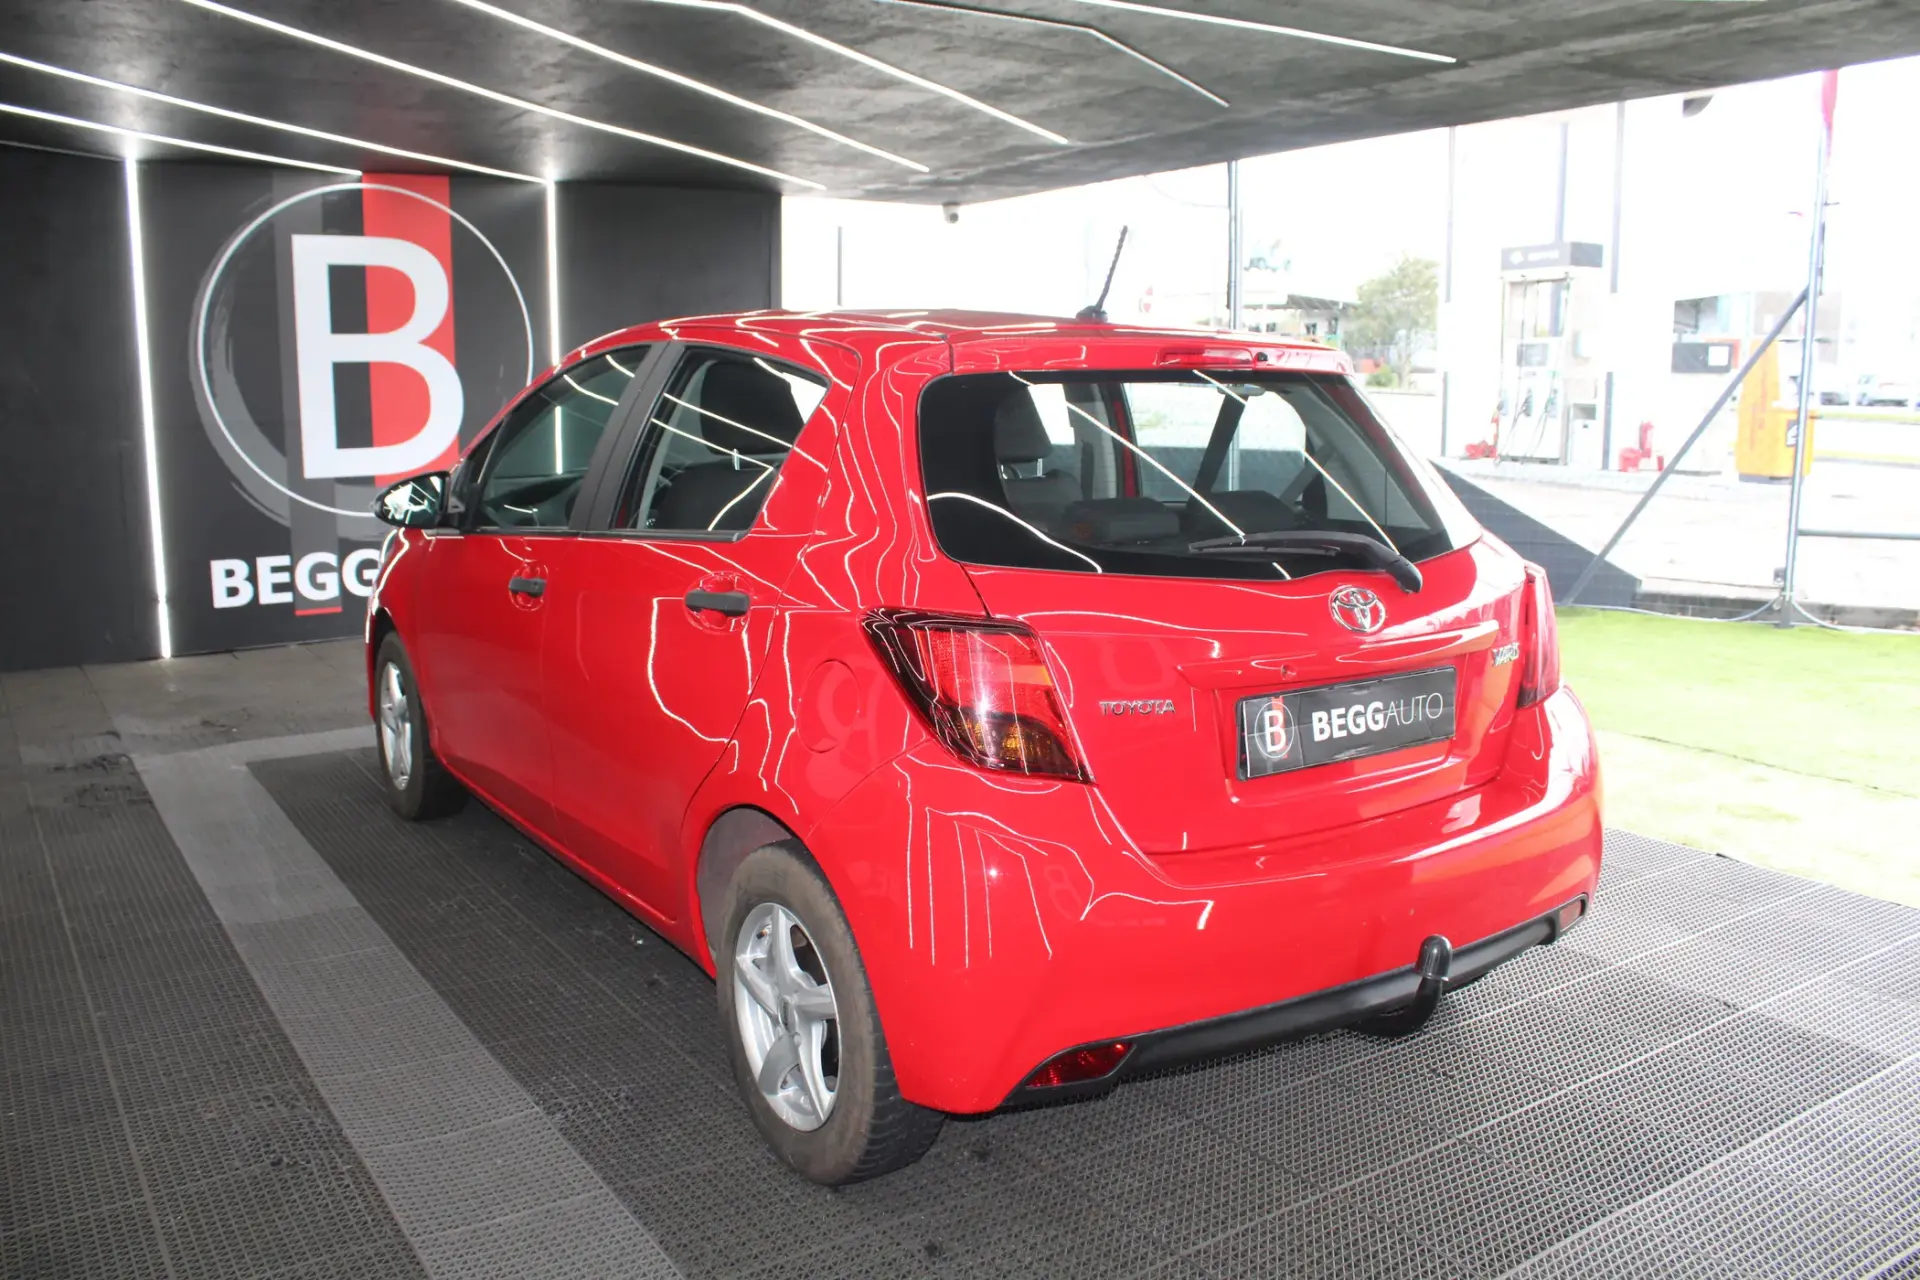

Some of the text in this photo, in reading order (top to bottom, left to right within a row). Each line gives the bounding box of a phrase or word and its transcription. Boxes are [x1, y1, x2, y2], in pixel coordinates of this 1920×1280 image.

[291, 234, 465, 480] B
[1099, 699, 1176, 715] TOYOTA
[1311, 692, 1443, 742] BEGGAUTO
[1263, 709, 1287, 752] B
